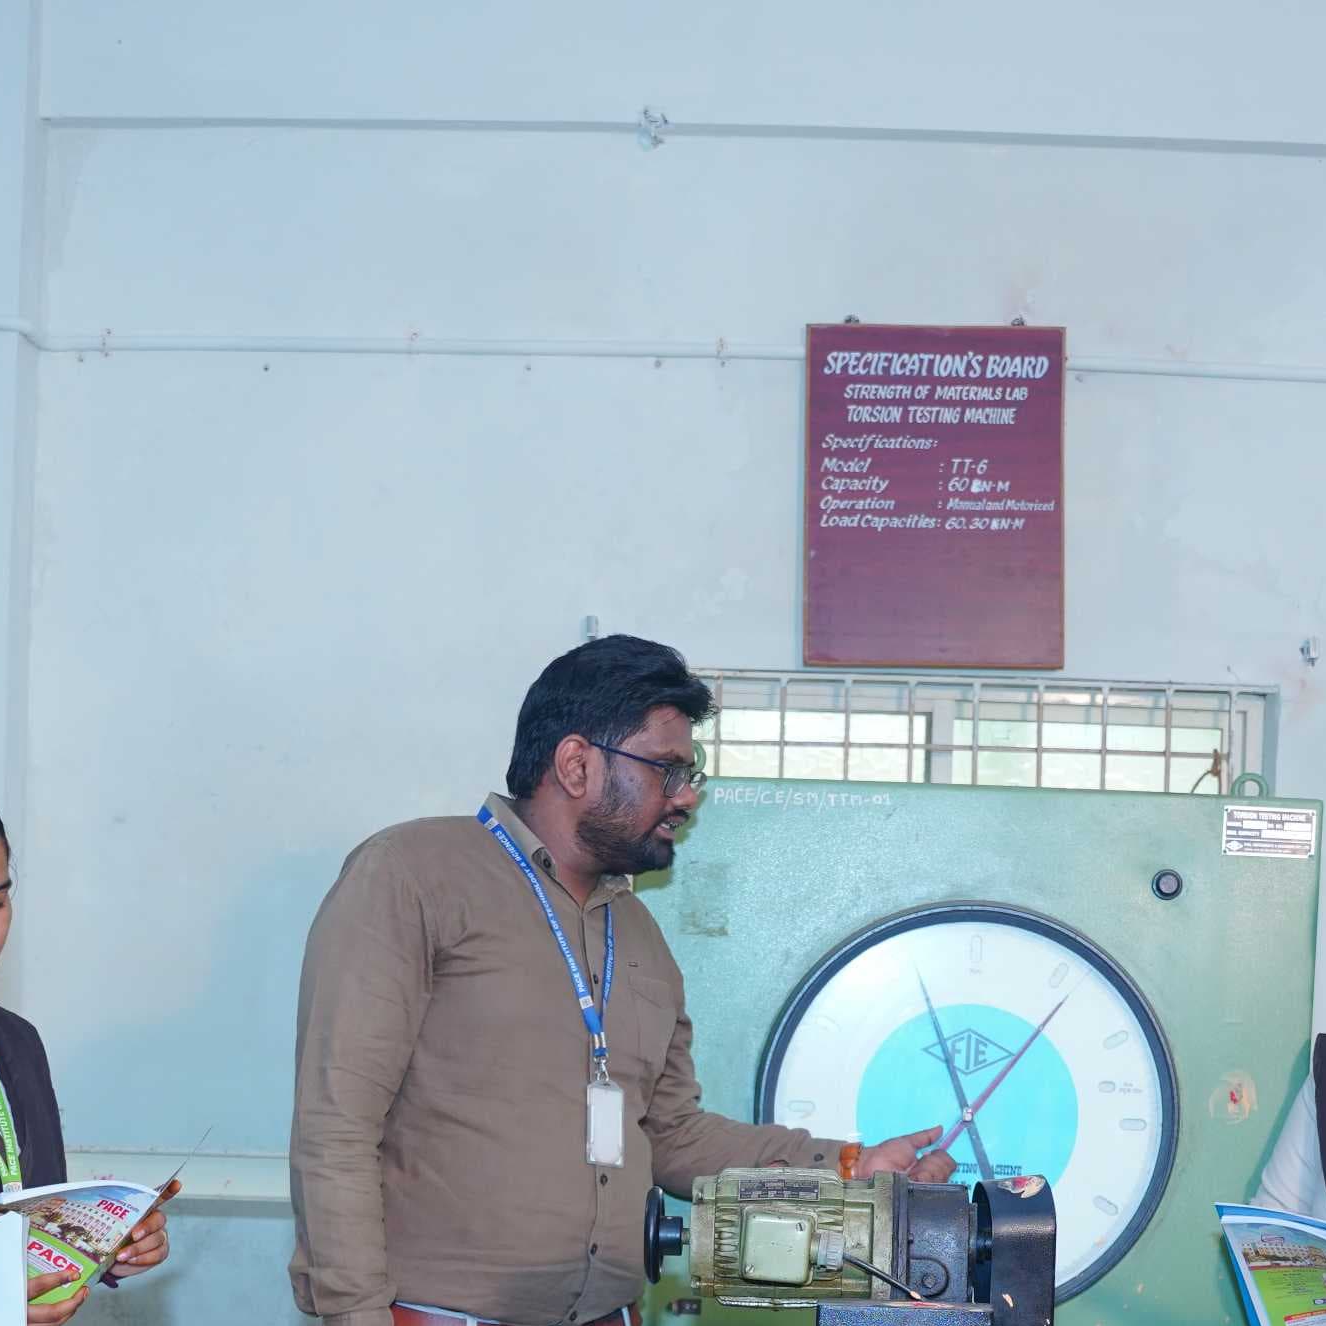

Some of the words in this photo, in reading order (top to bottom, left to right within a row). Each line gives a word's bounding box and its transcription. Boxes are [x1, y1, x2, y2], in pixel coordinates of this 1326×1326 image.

[824, 351, 984, 378] SPECIFICATION'S
[986, 355, 1050, 379] BOARD
[844, 384, 911, 400] STRENGTH
[914, 386, 929, 400] OF
[935, 386, 1002, 401] MATERIALS
[1005, 387, 1029, 401] LAB
[847, 405, 902, 424] TORSION
[908, 407, 960, 425] TESTING
[963, 408, 1017, 425] MACHINE
[821, 457, 871, 473] Model
[950, 458, 988, 474] TT-6
[821, 476, 890, 493] Capacity
[947, 477, 969, 493] 60
[819, 496, 895, 513] Operation
[819, 514, 858, 529] Load
[494, 829, 522, 862] SCIENCES
[555, 930, 578, 972] INSTITUTE
[950, 1034, 989, 1071] FIE
[8, 1154, 19, 1177] PACE
[97, 1200, 131, 1221] PACE
